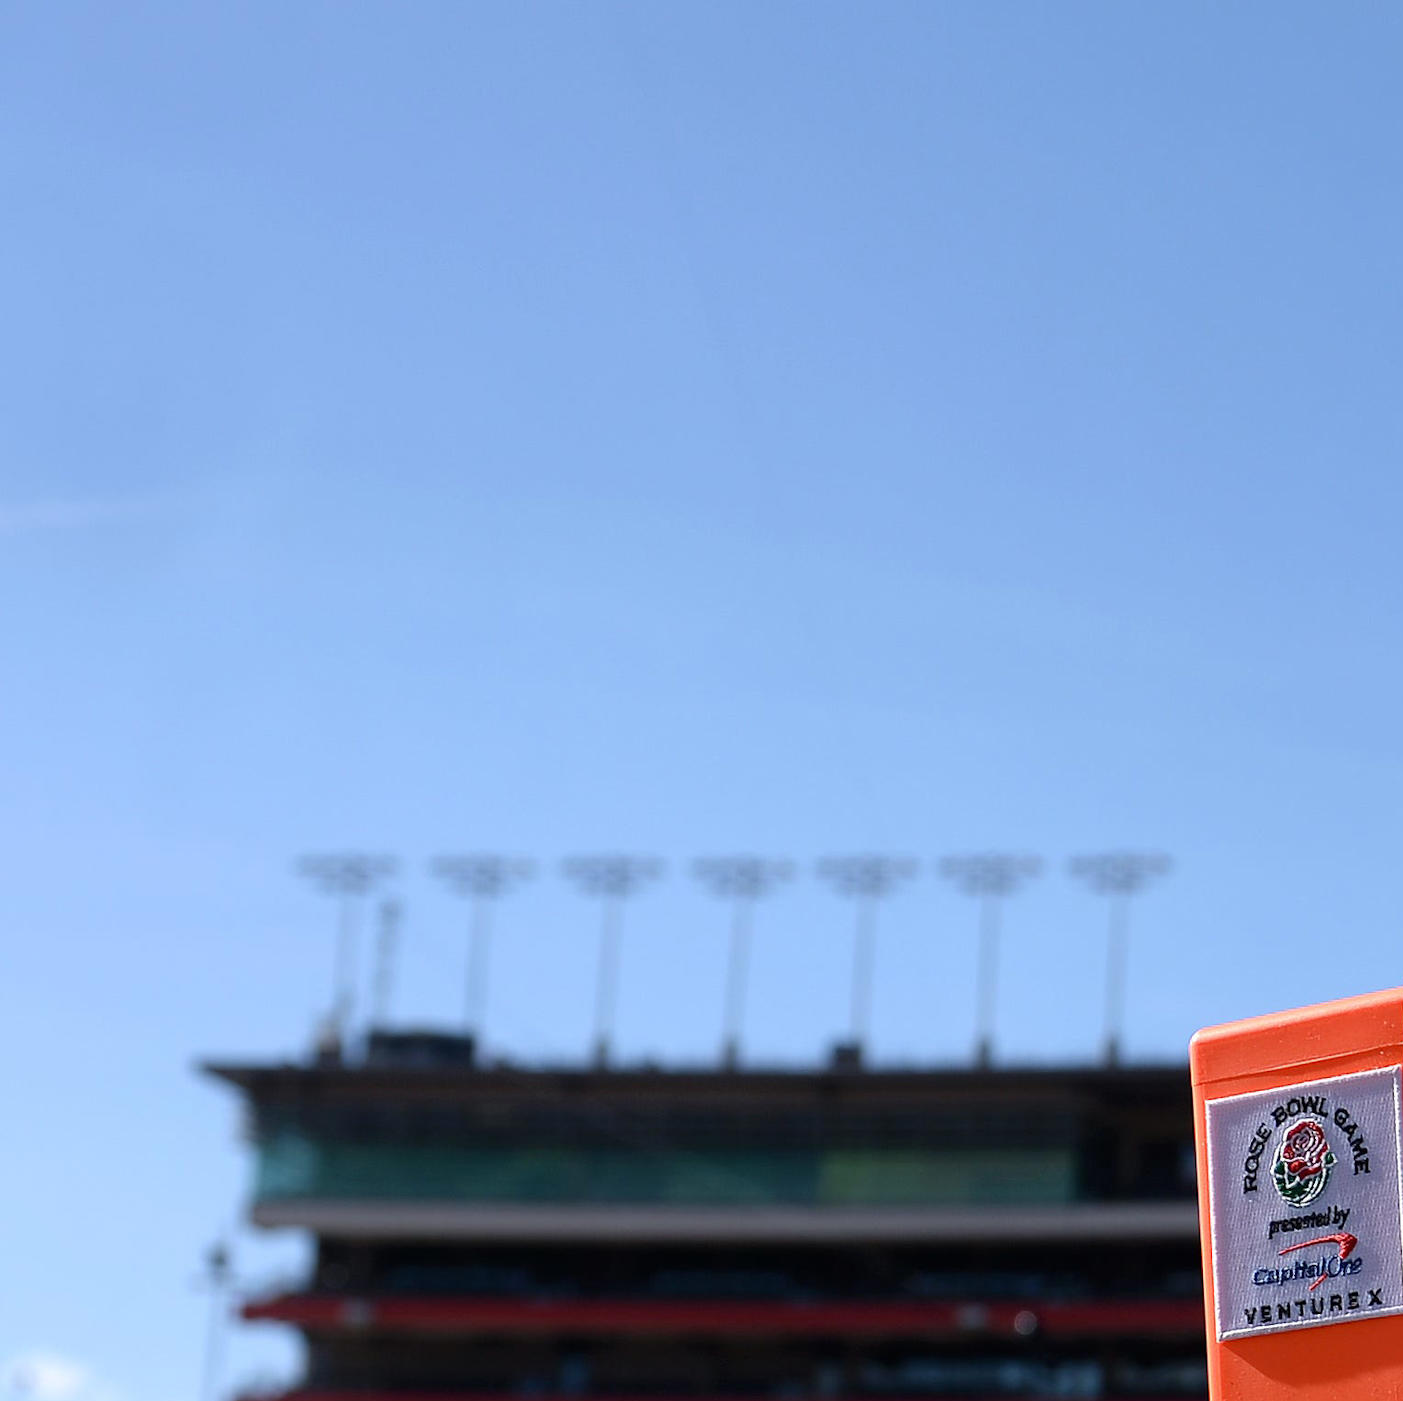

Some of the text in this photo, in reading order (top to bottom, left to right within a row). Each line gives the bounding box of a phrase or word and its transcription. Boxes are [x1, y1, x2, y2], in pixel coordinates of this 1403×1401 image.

[1243, 1096, 1371, 1194] ROSE BOWL GAME
[1268, 1206, 1350, 1239] presented by
[1244, 1288, 1383, 1324] VENTURE X
